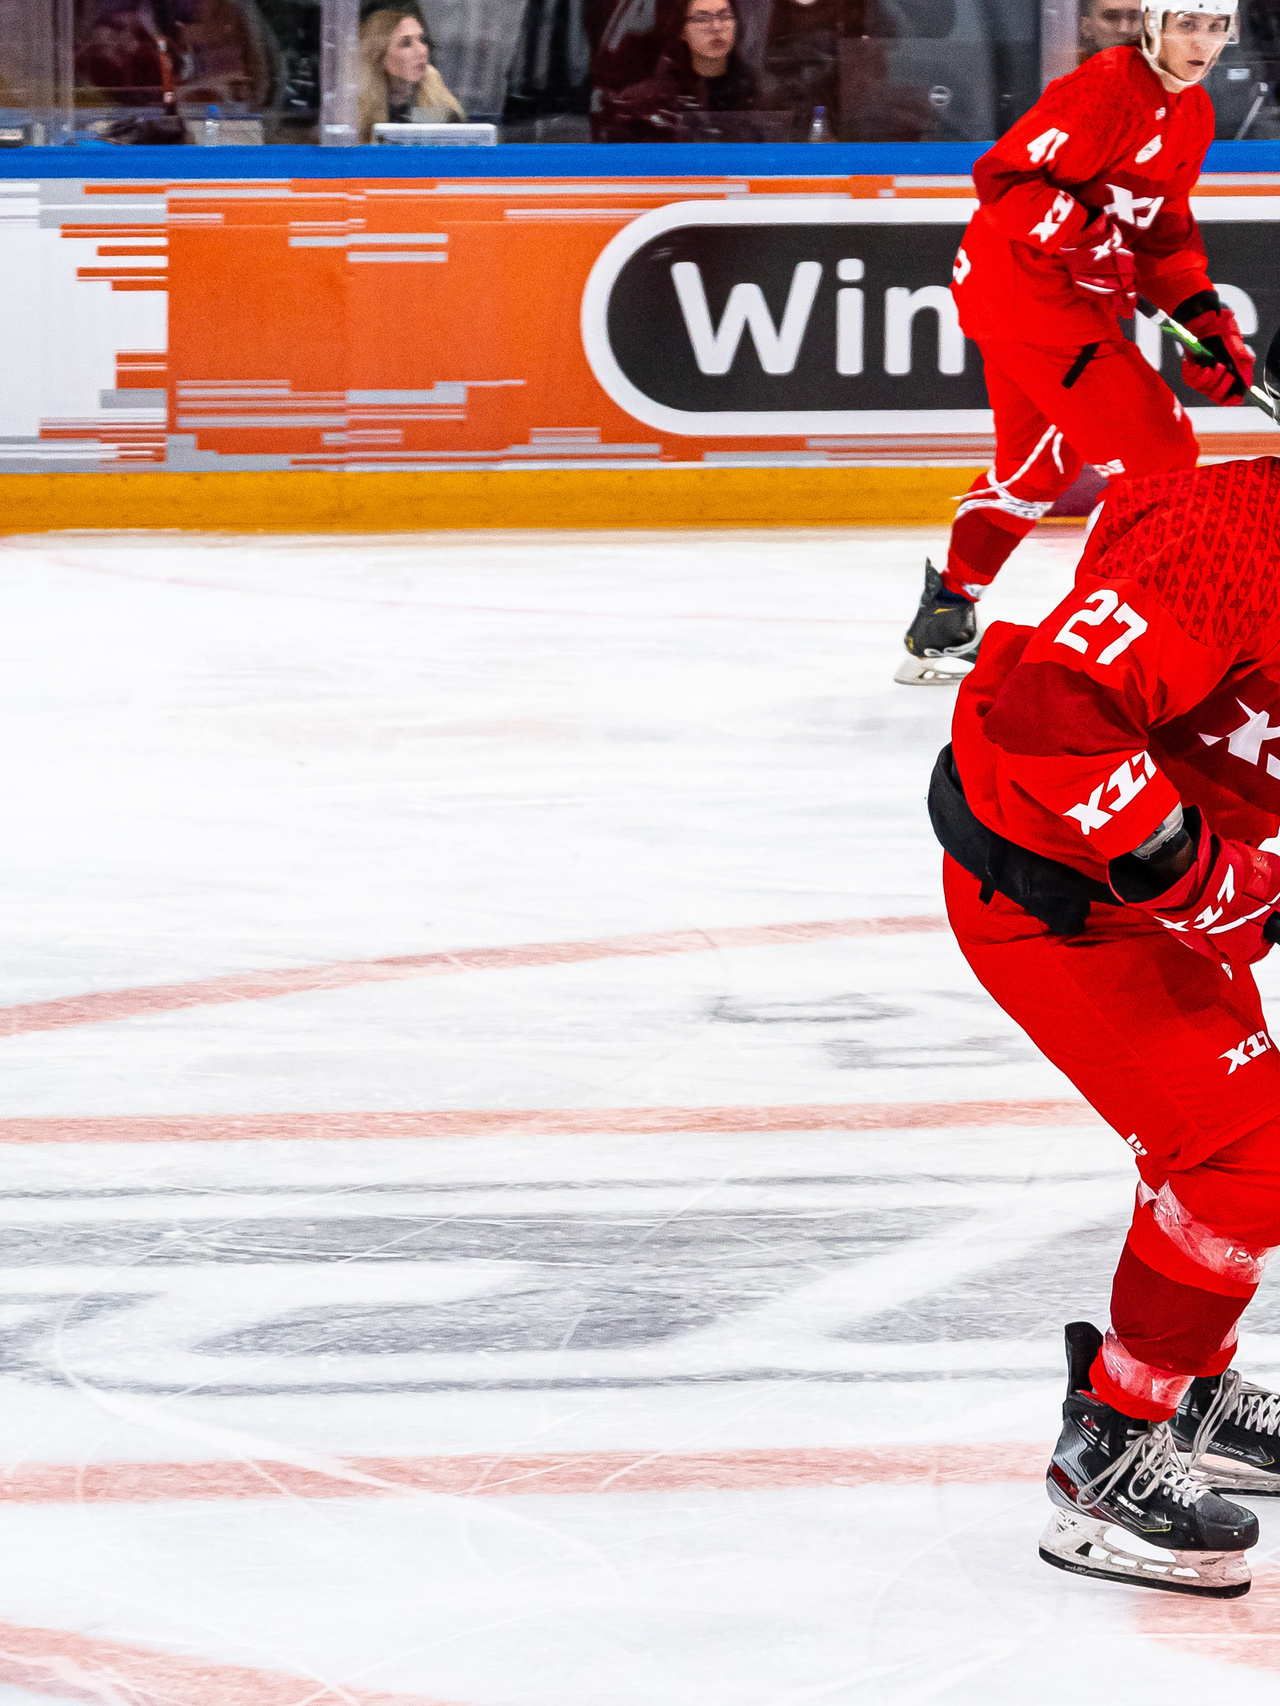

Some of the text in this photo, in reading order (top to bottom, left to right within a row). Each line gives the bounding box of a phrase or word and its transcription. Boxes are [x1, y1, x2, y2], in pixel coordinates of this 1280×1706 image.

[1026, 127, 1069, 164] 41
[670, 258, 1259, 376] Wine
[1053, 588, 1148, 666] 27
[1062, 750, 1157, 836] X17
[1217, 1030, 1272, 1075] X17
